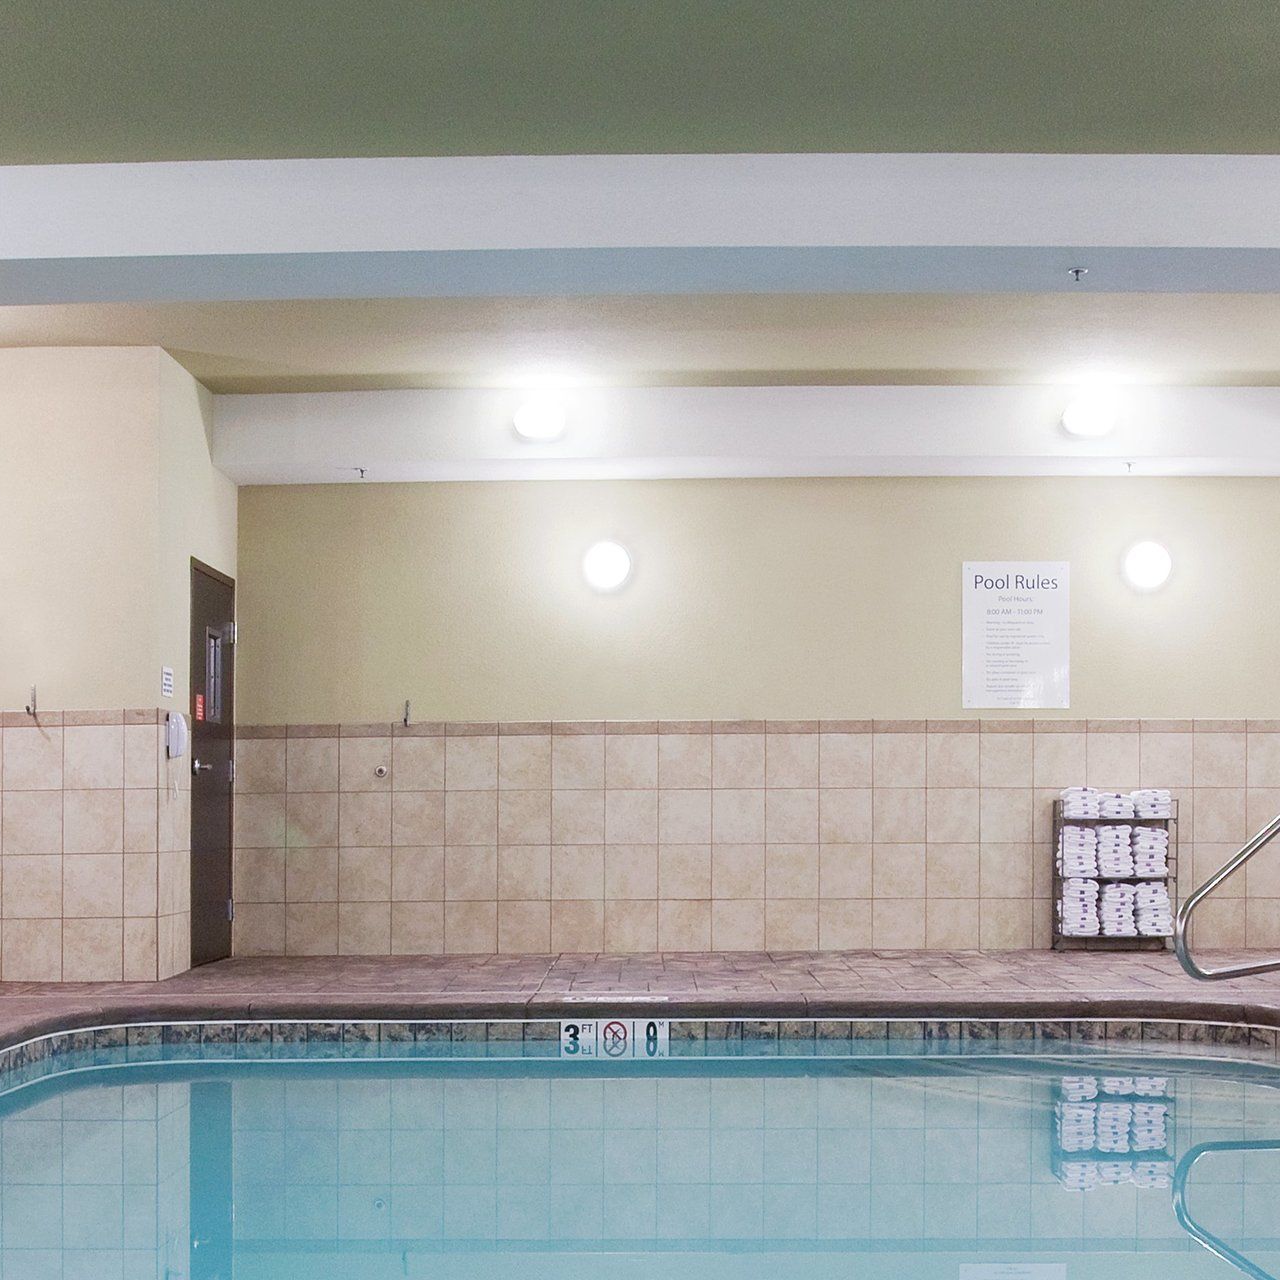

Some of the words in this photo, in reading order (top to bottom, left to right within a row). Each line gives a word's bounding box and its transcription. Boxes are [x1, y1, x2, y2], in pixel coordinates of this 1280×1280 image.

[975, 574, 1009, 590] Pool
[1015, 574, 1058, 590] Rules
[581, 1023, 592, 1033] FT
